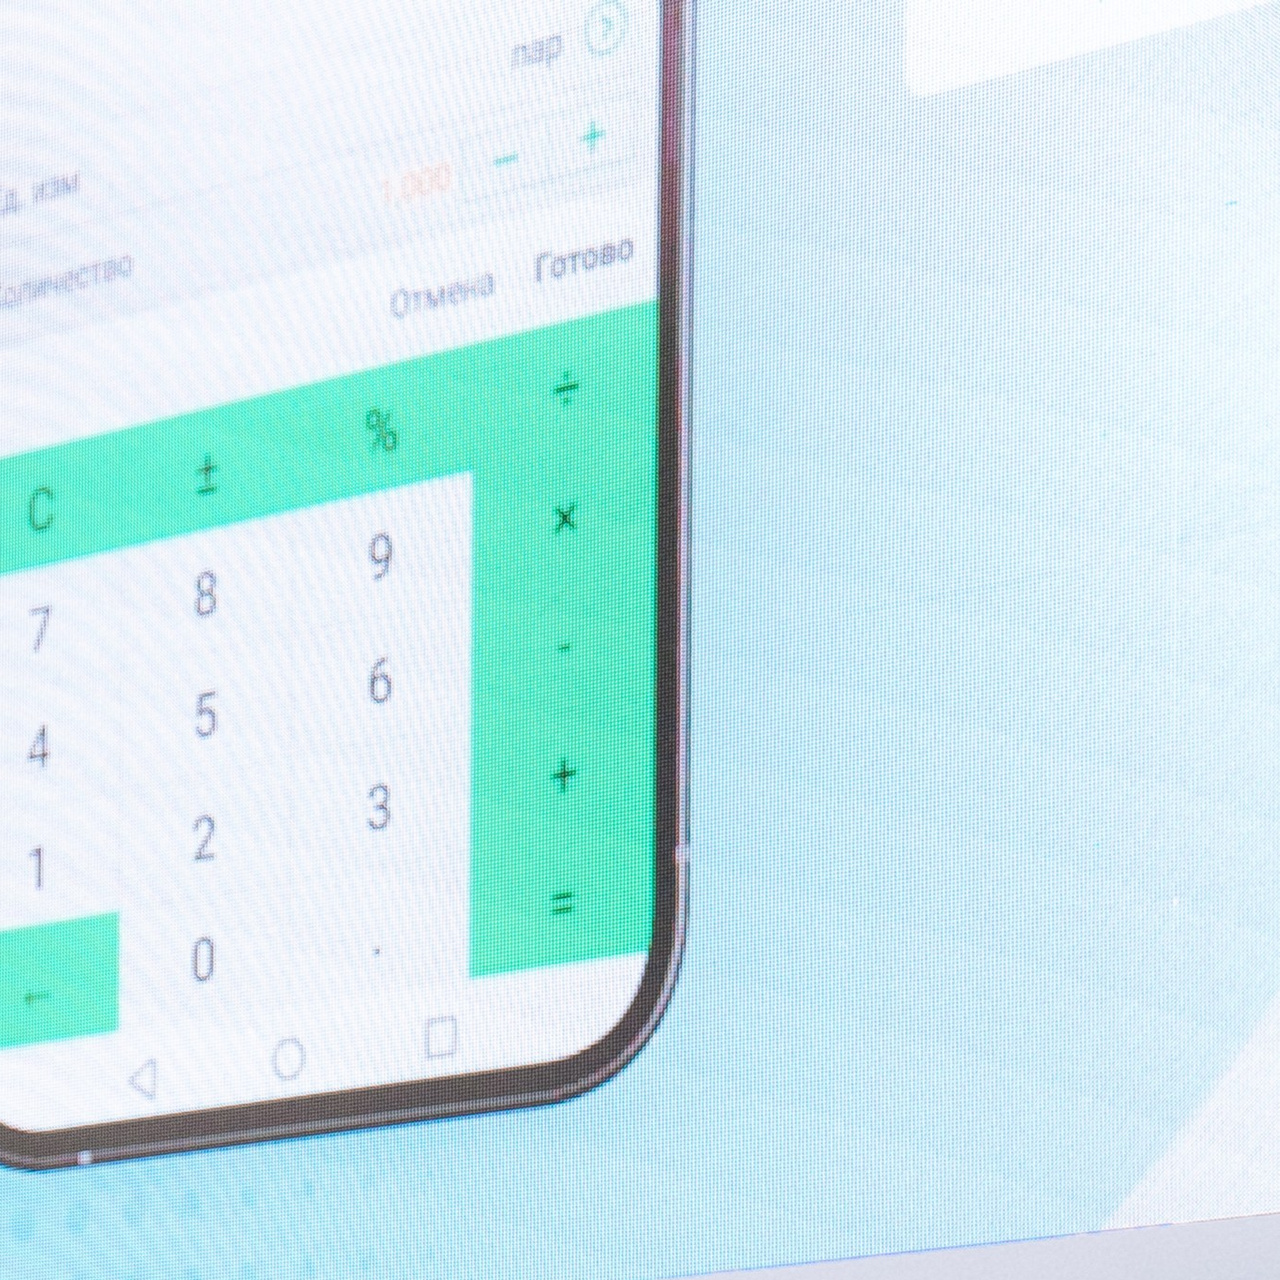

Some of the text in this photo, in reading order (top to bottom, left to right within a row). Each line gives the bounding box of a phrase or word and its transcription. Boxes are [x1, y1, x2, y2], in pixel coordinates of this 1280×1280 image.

[391, 238, 635, 320] Отмена Готово
[369, 532, 392, 579] 9
[196, 570, 217, 616] 8
[29, 605, 52, 652] 7
[369, 657, 392, 703] 6
[196, 690, 217, 737] 5
[28, 725, 50, 768] 4
[368, 784, 391, 830] 3
[193, 814, 216, 860] 2
[29, 846, 42, 890] 1
[192, 936, 215, 982] 0
